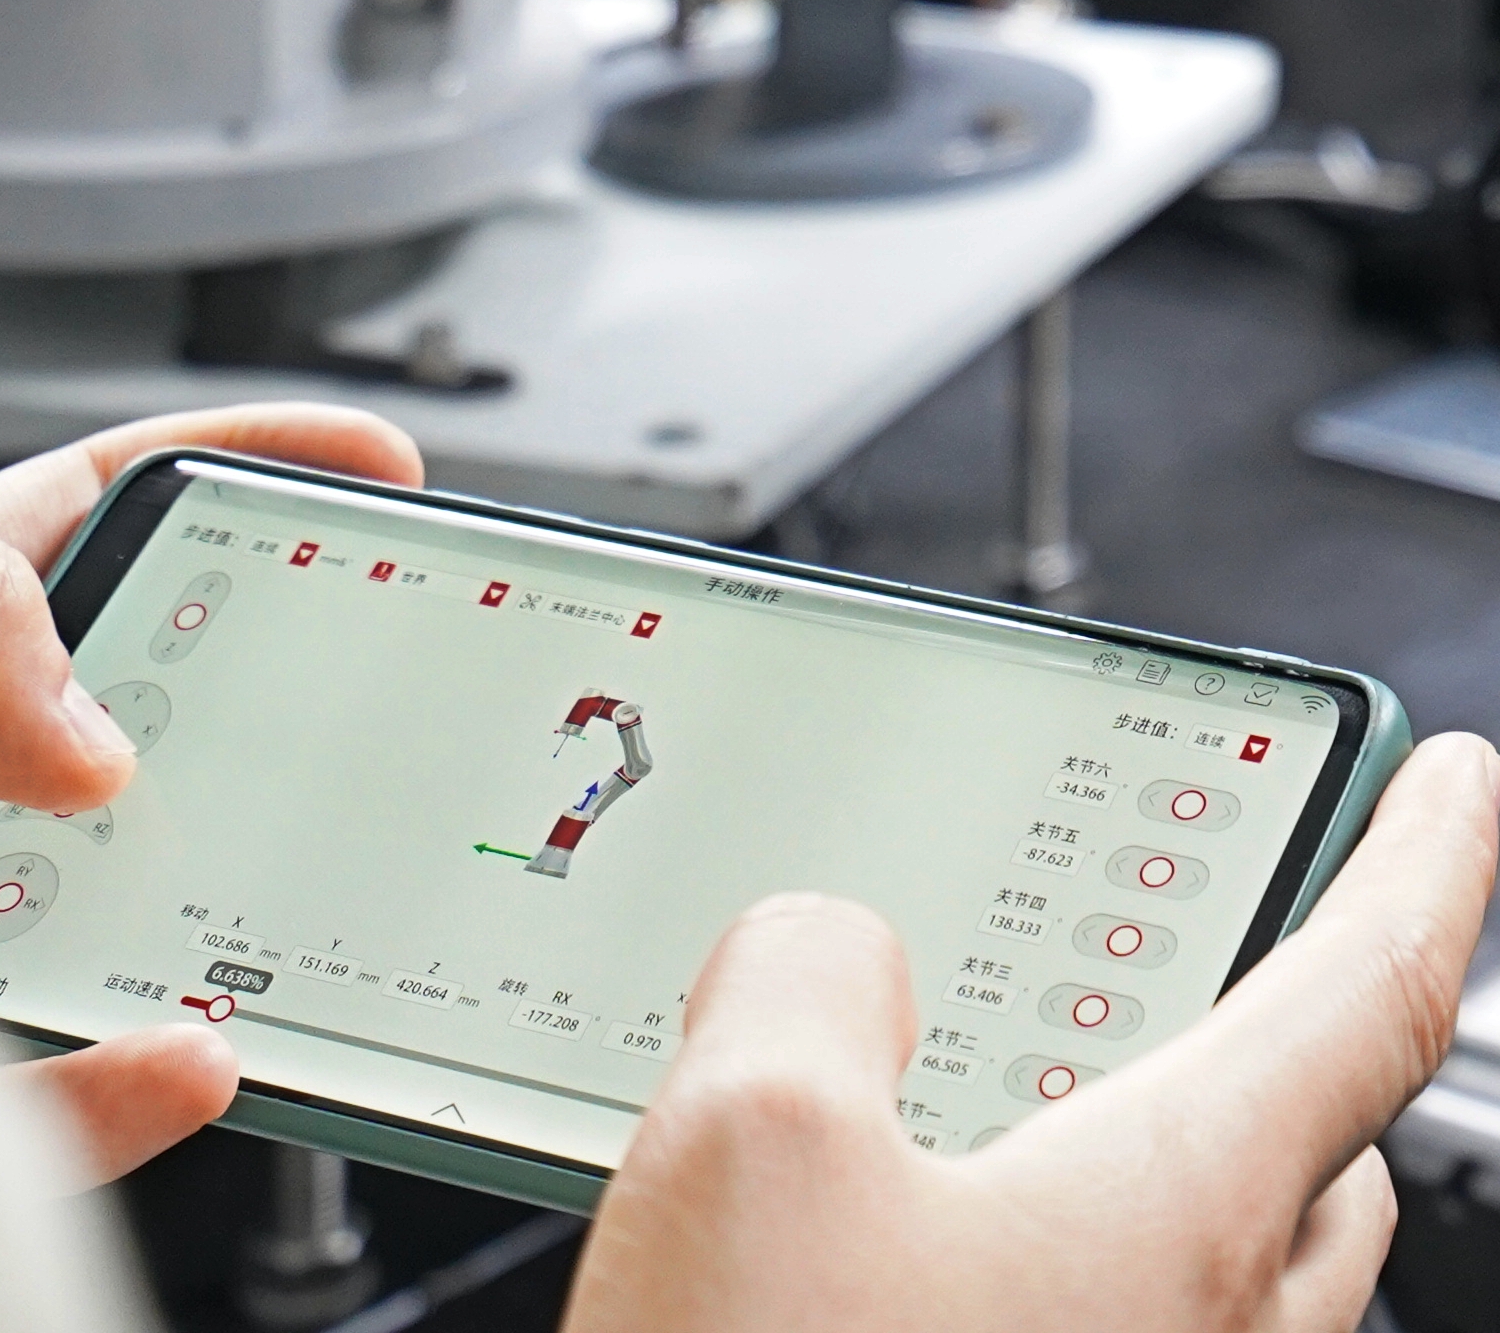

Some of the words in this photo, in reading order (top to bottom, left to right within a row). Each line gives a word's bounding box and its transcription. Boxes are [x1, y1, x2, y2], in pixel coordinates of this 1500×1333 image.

[703, 576, 786, 605] 手动操作
[1193, 732, 1227, 749] 连续
[1060, 755, 1112, 779] 关节六
[1056, 782, 1106, 802] -34.366
[93, 822, 110, 834] RZ
[1027, 821, 1081, 845] 关节五
[1022, 848, 1073, 868] -87.623
[16, 865, 33, 877] RY
[23, 898, 41, 910] RX
[994, 888, 1047, 911] 关节四
[180, 903, 210, 922] 移动
[232, 915, 245, 929] X
[988, 914, 1042, 937] 138.333
[200, 932, 251, 955] 102.686
[259, 947, 282, 962] mm
[331, 938, 342, 951] Y
[298, 955, 349, 977] 151.169
[357, 971, 380, 985] mm
[428, 961, 441, 975] Z
[959, 957, 1013, 981] 关节三
[103, 973, 169, 1001] 运动速度
[211, 965, 266, 990] 6.638%
[396, 978, 449, 1001] 420.664
[457, 994, 481, 1008] mm
[498, 977, 529, 997] 旋转
[552, 990, 573, 1006] RX
[956, 984, 1003, 1005] 63.406
[522, 1009, 580, 1032] -177.208
[644, 1012, 665, 1027] RY
[623, 1032, 662, 1051] 0.970
[925, 1026, 978, 1051] 关节二
[921, 1055, 970, 1077] 66.505
